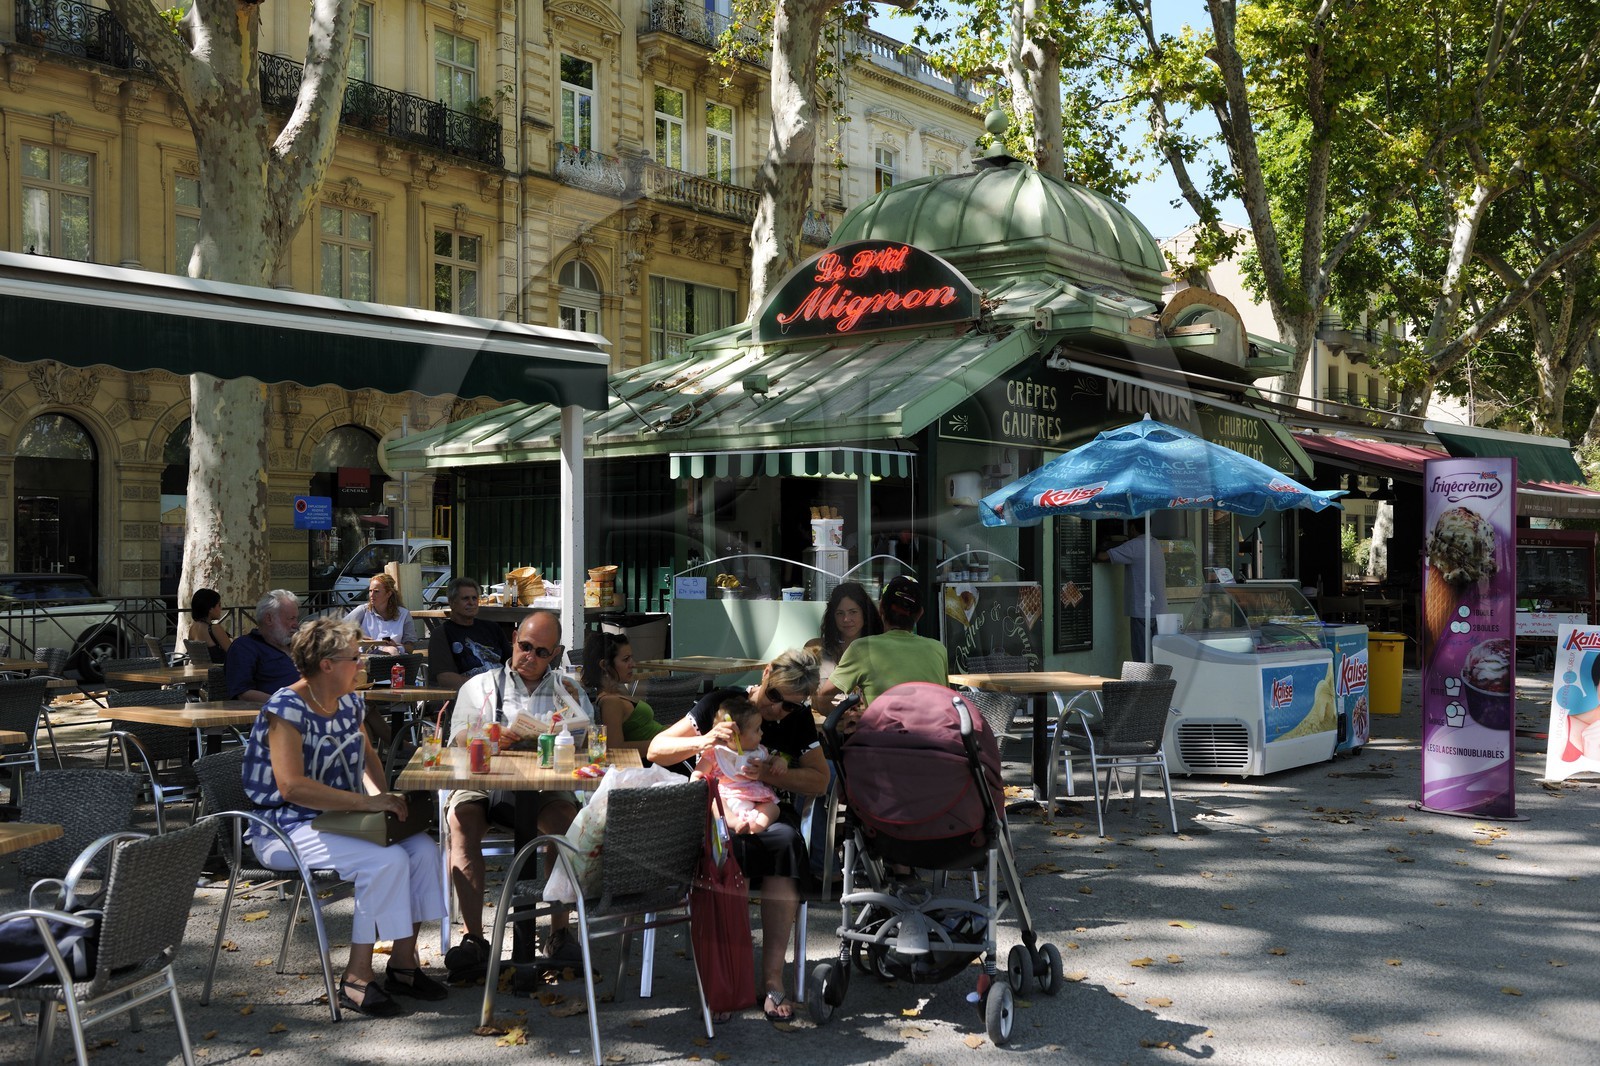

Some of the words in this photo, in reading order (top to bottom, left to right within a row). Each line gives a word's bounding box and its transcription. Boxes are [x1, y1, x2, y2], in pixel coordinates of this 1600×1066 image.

[814, 253, 847, 283] Le
[776, 283, 958, 332] Mignon
[1006, 376, 1058, 411] CRÊPES
[1106, 378, 1191, 422] MIGNON
[1002, 410, 1062, 441] GAUFRES
[1218, 414, 1259, 440] CHURROS
[1212, 439, 1264, 464] DWICHS
[1040, 486, 1105, 508] Kalise
[1430, 476, 1498, 497] frigécrème
[1339, 654, 1368, 697] Kalise
[1272, 678, 1294, 708] Kalise
